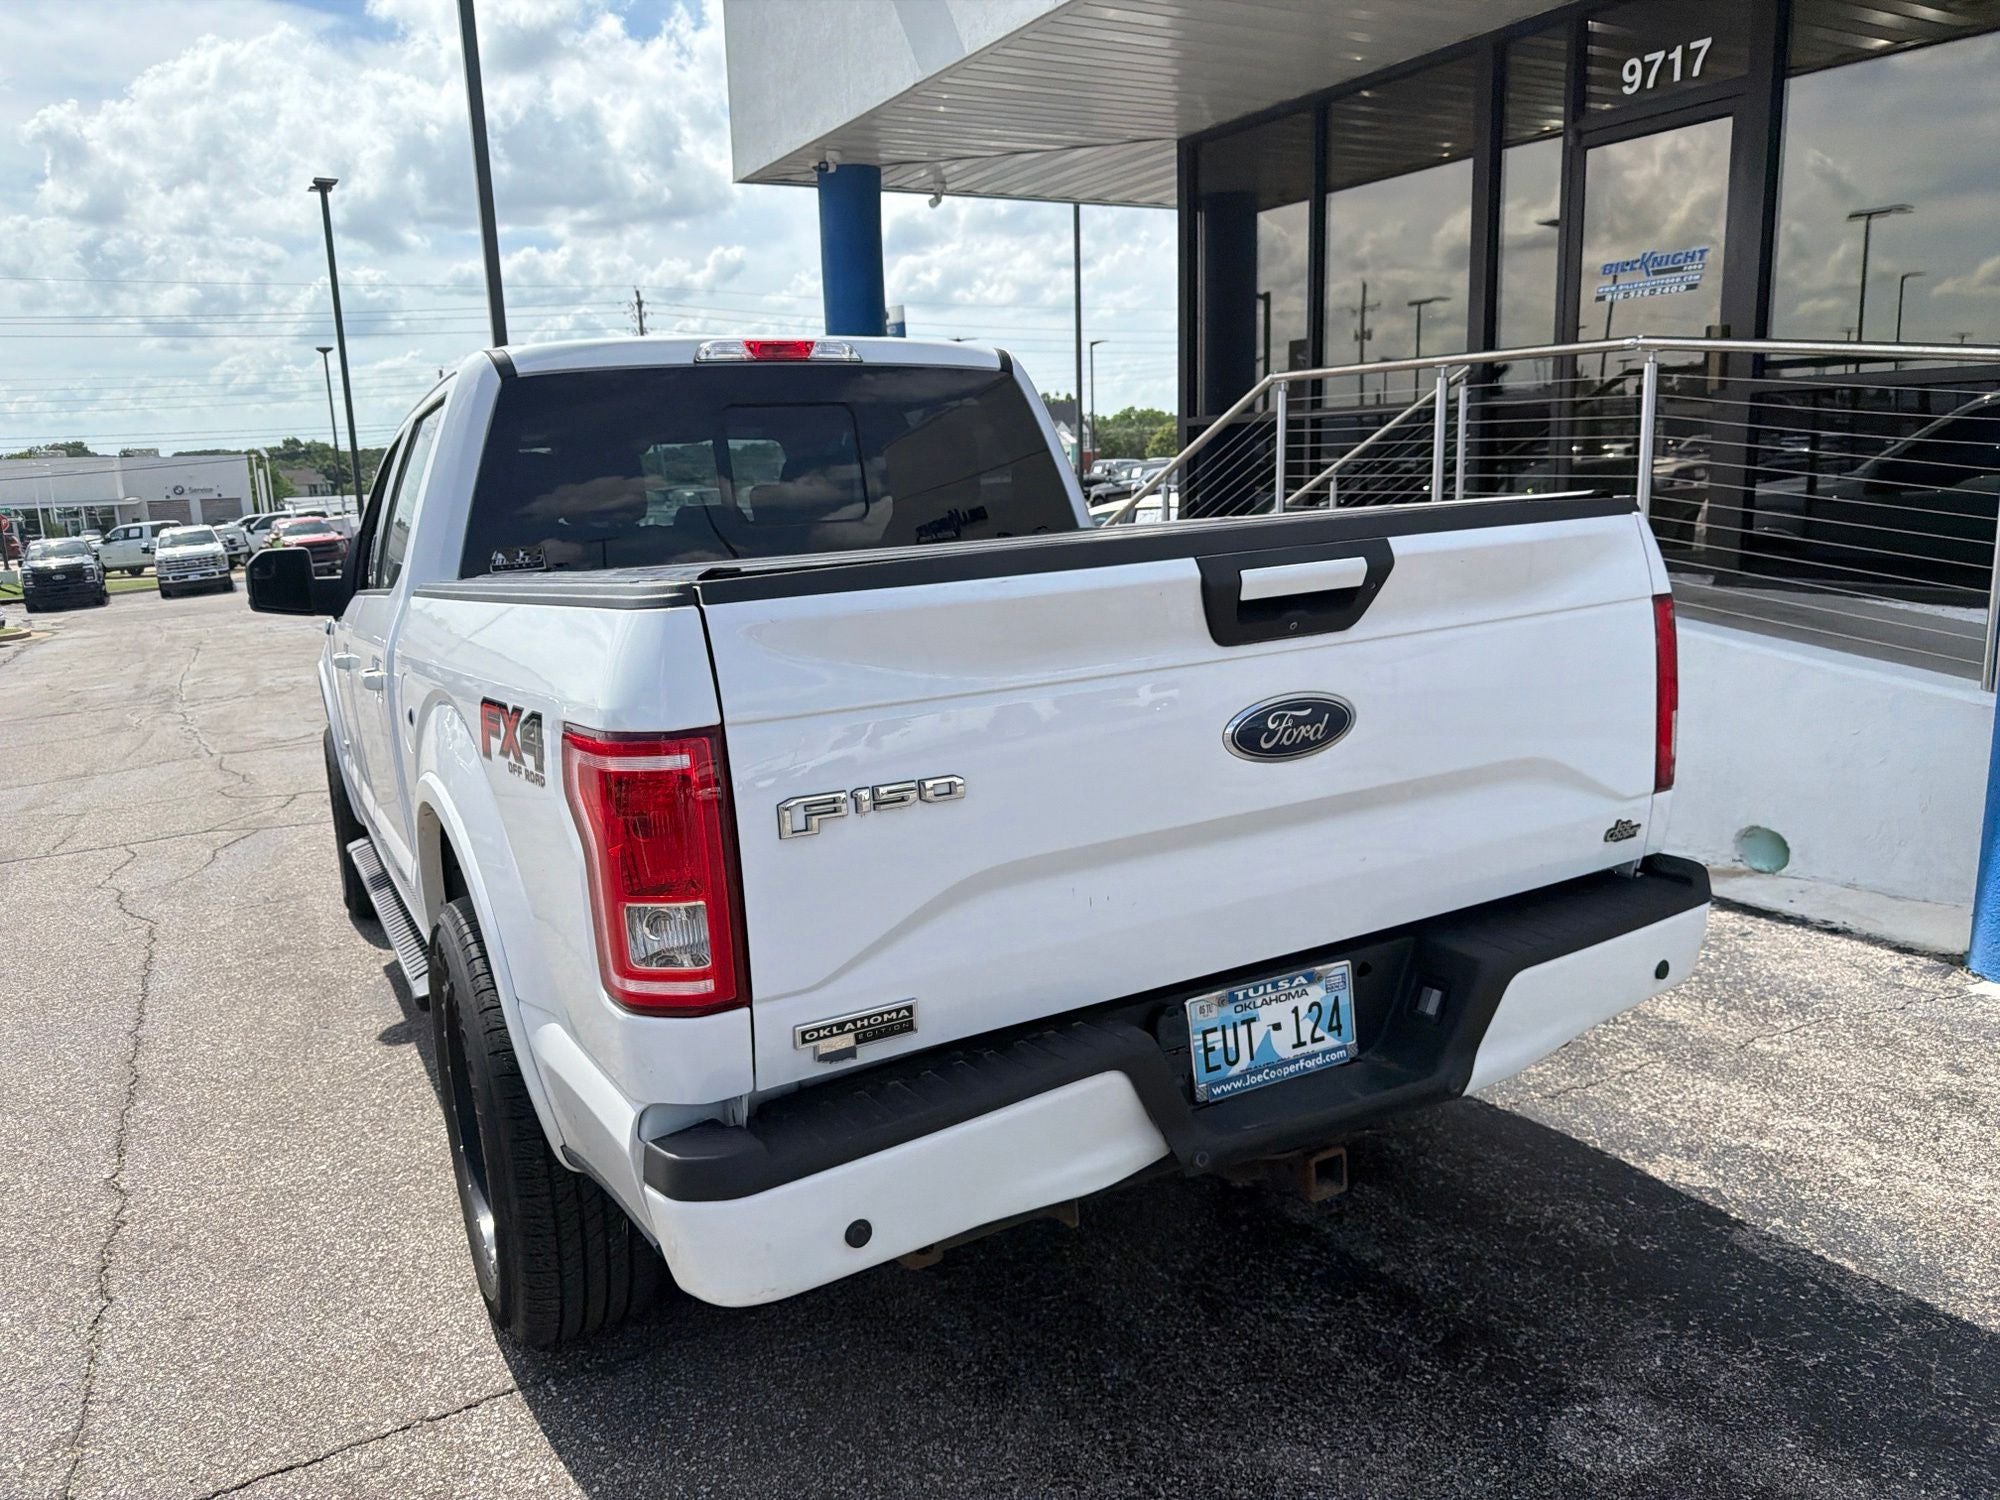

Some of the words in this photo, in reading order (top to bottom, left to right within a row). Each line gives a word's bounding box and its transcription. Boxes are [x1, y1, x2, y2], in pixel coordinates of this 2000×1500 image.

[1621, 36, 1712, 95] 9717
[480, 696, 545, 774] FX4
[1260, 708, 1330, 749] Ford
[508, 761, 523, 777] OFF
[524, 768, 546, 788] ROAD
[1233, 975, 1309, 1001] TULSA
[1233, 988, 1310, 1014] OKLAHOMA
[804, 1008, 910, 1041] OKLAHOMA
[858, 1022, 910, 1040] EDITION
[1201, 1016, 1258, 1074] EUT
[1291, 995, 1344, 1050] 124
[1211, 1049, 1348, 1096] www.JoeCooperFord.com
